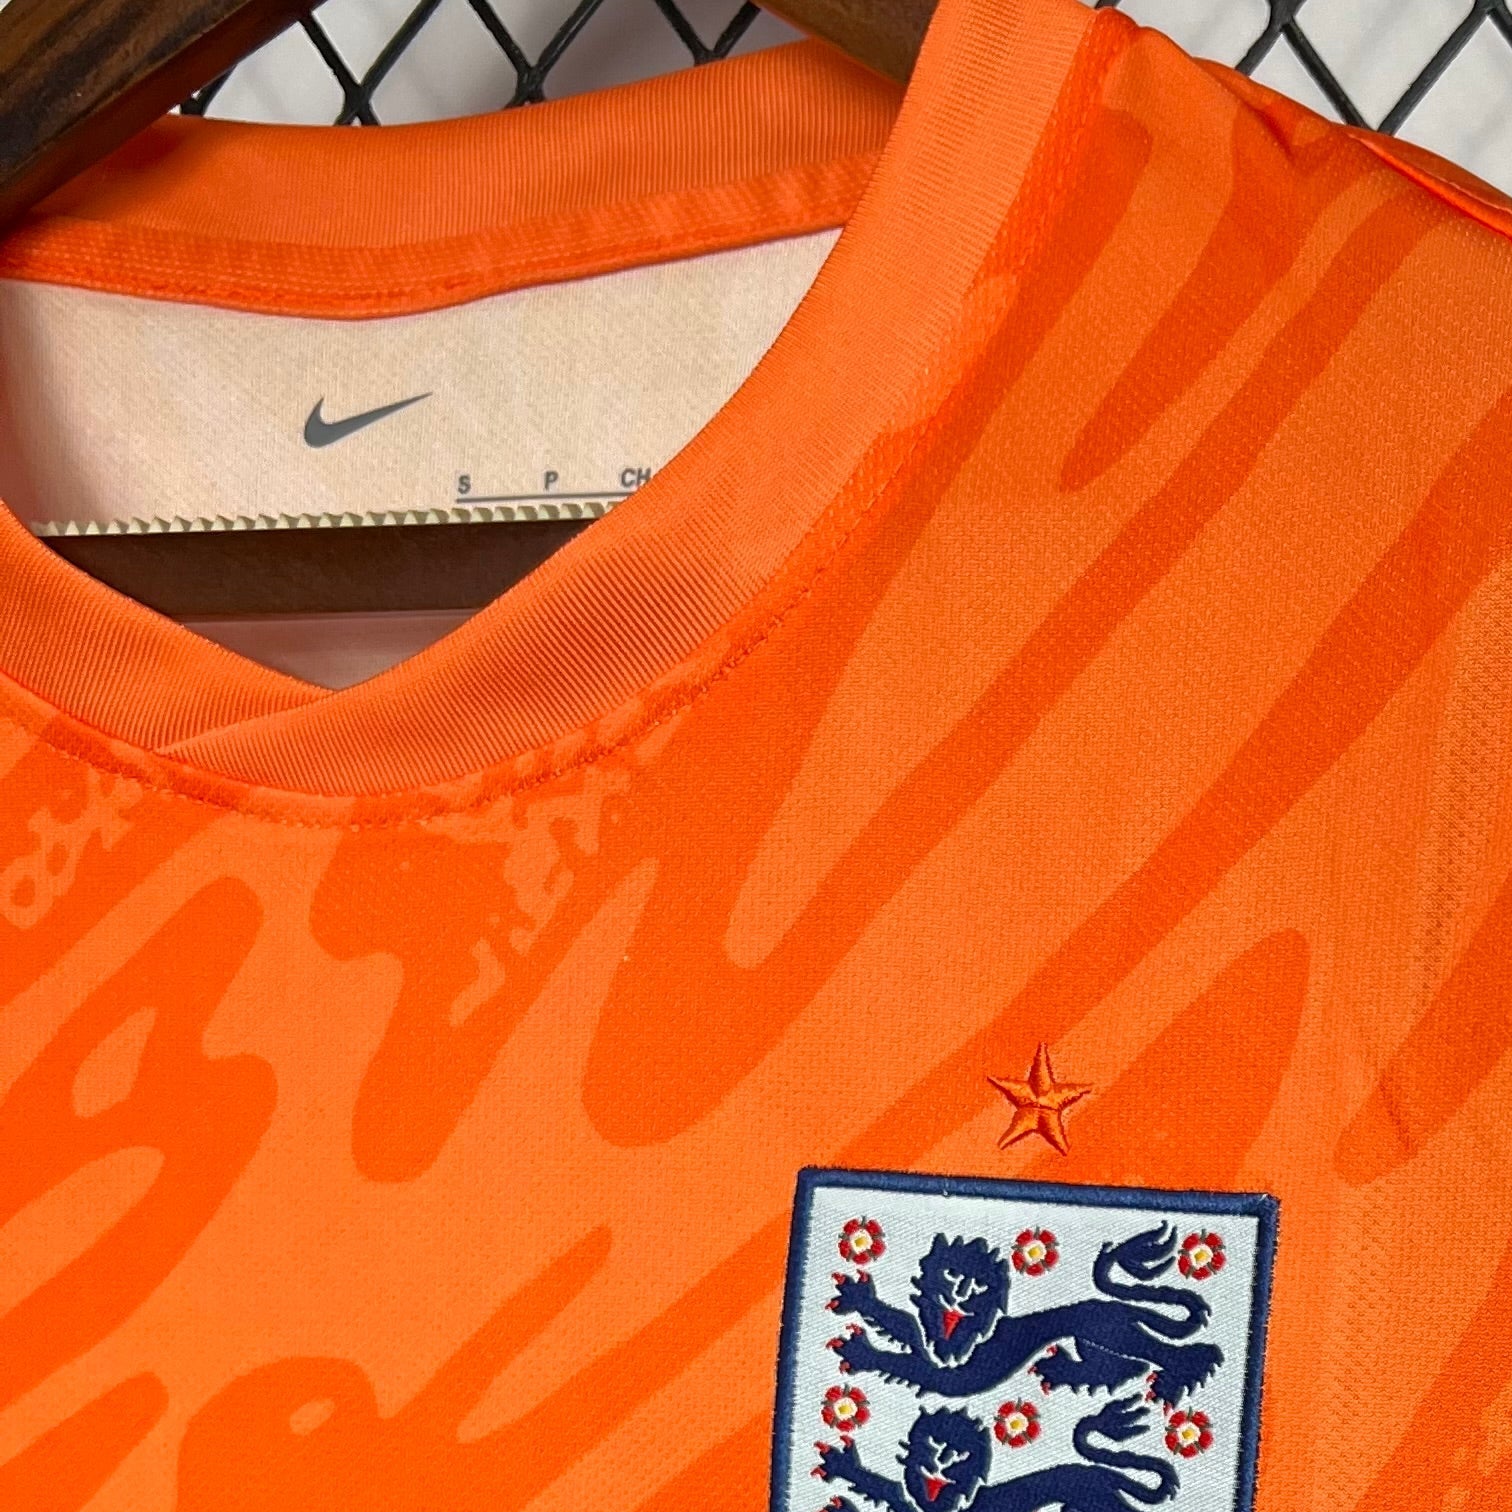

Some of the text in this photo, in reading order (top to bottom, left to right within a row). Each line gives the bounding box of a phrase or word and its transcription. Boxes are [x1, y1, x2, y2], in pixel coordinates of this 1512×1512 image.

[457, 467, 650, 494] S P CH
